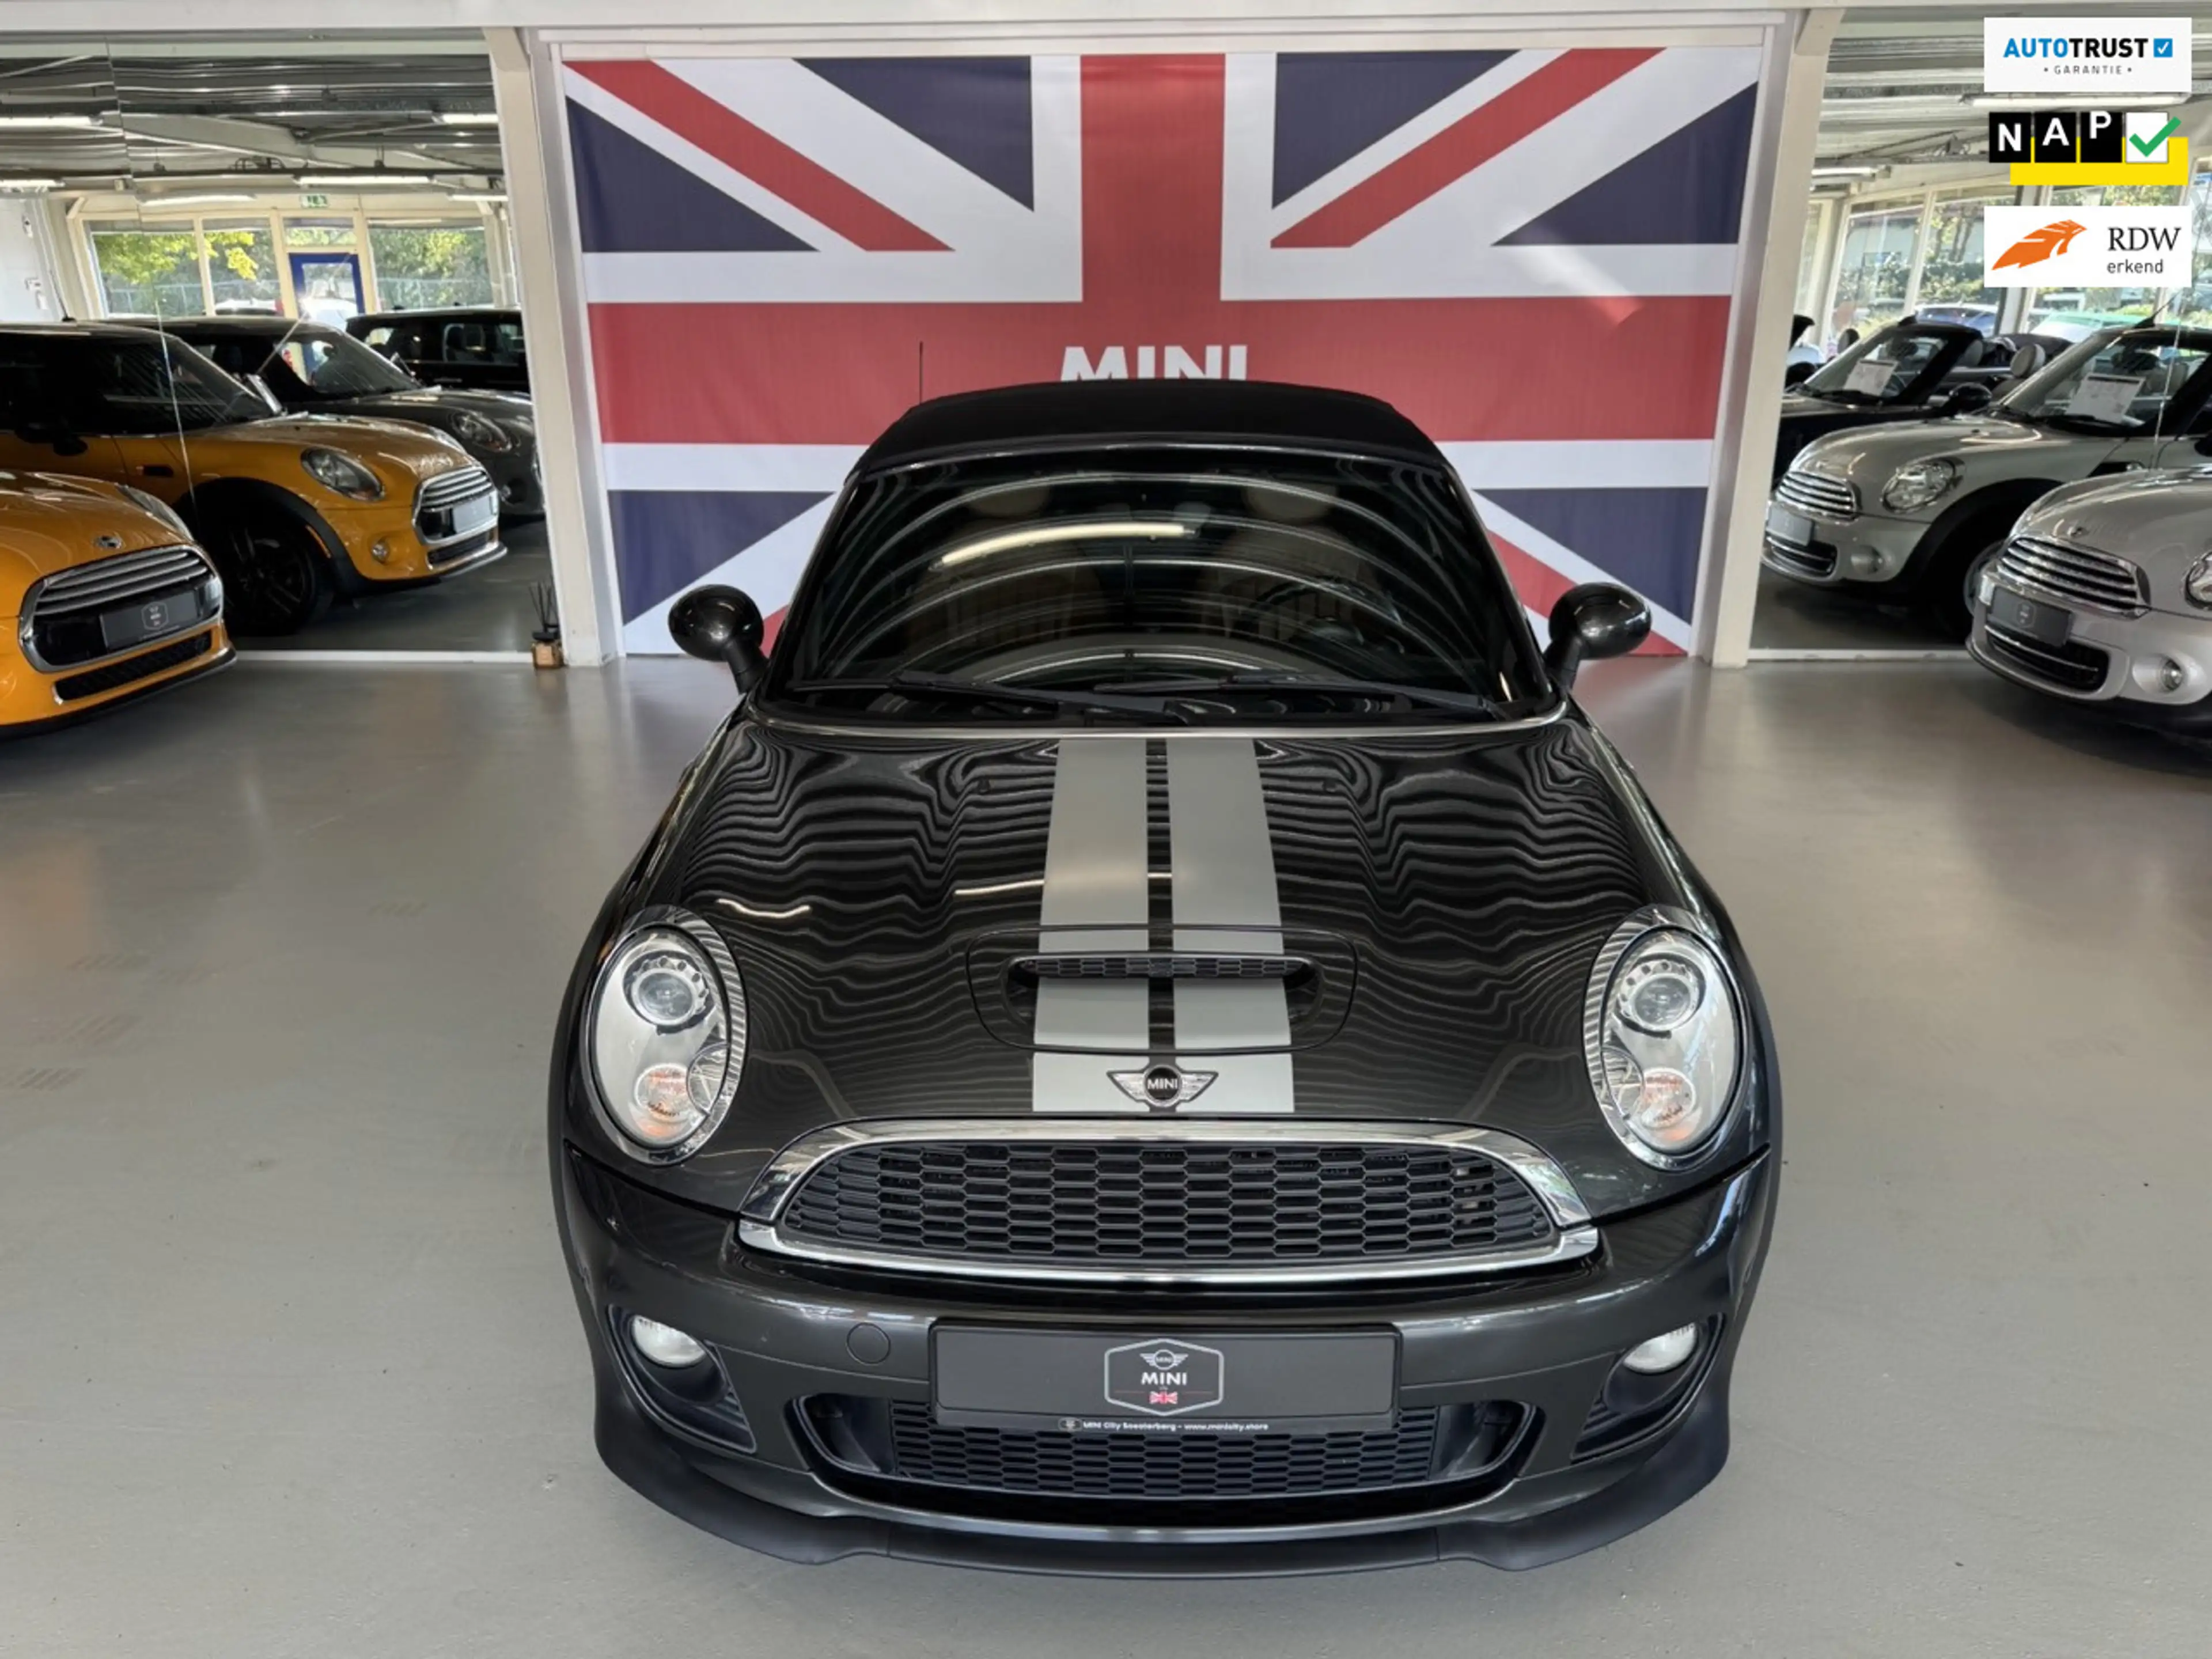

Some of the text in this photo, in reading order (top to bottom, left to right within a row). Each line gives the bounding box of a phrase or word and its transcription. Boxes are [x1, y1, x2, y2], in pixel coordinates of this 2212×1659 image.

[1060, 344, 1248, 381] MINI
[1147, 1077, 1178, 1090] MINI
[1141, 1372, 1188, 1385] MINI
